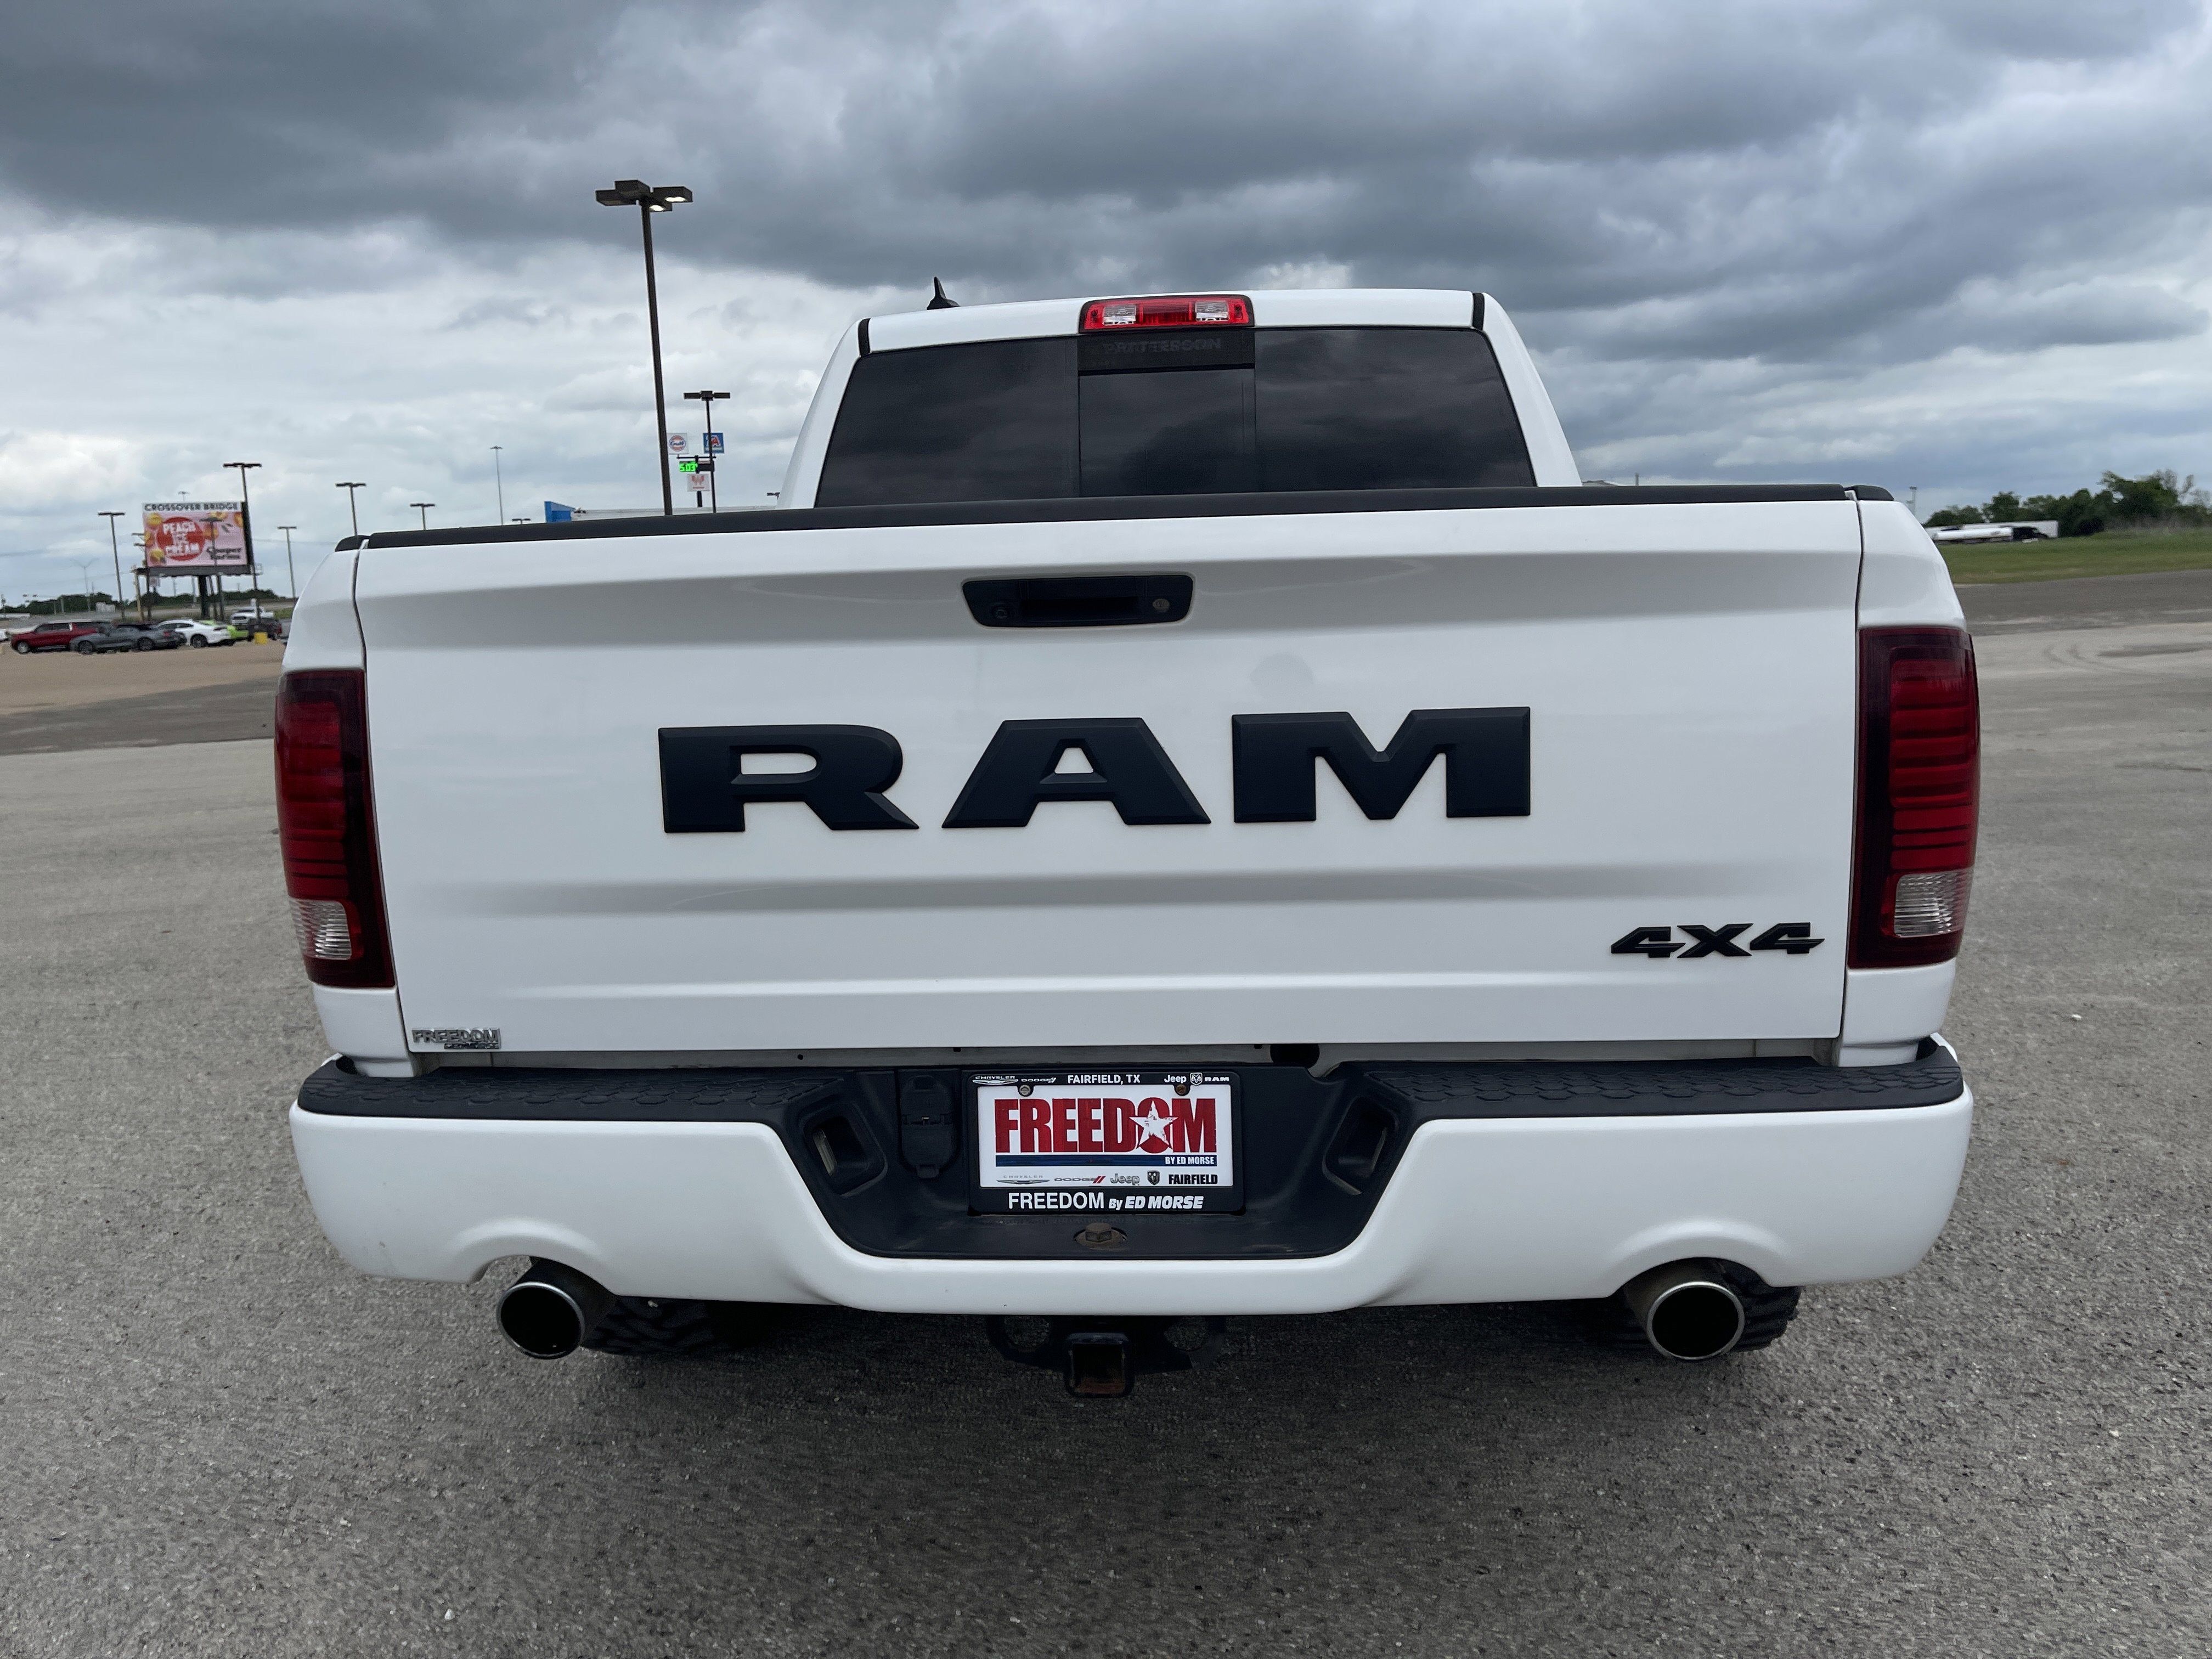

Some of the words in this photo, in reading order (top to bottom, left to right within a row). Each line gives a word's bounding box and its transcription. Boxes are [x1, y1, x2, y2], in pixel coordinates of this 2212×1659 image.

[145, 503, 201, 511] CROSSOVER
[163, 522, 196, 534] PEACH
[165, 543, 200, 555] CREAM
[658, 706, 1531, 833] RAM
[411, 1028, 501, 1043] FREEDOM
[1068, 1075, 1123, 1085] FAIRFIELD,
[1126, 1074, 1141, 1083] TX
[1164, 1075, 1187, 1084] Jeep
[994, 1097, 1217, 1154] FREEDOM
[1165, 1156, 1175, 1165] BY
[1177, 1156, 1187, 1165] ED
[1188, 1156, 1215, 1165] MORSE
[1110, 1173, 1140, 1186] Jeep
[1168, 1174, 1218, 1184] FAIRFIELD
[1008, 1192, 1104, 1209] FREEDOM
[1108, 1198, 1124, 1210] By
[1125, 1197, 1146, 1209] ED
[1147, 1196, 1204, 1209] MORSE
